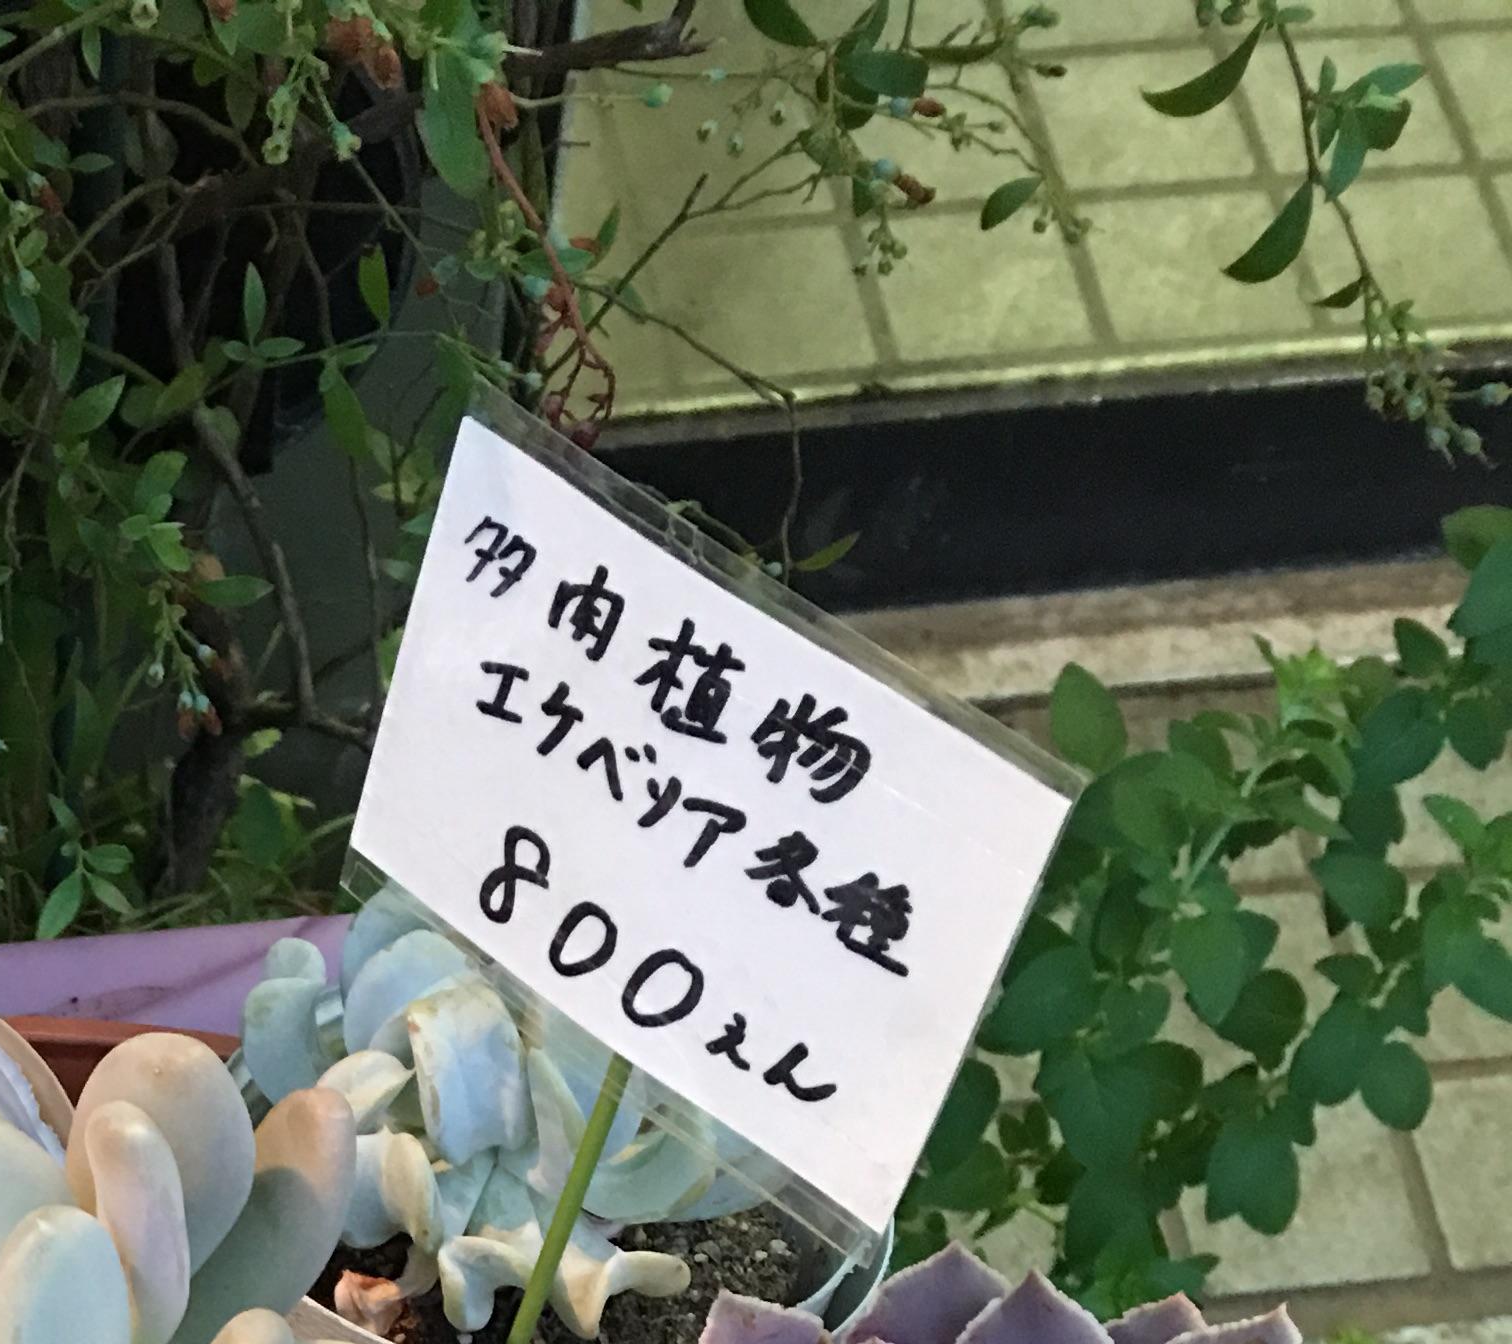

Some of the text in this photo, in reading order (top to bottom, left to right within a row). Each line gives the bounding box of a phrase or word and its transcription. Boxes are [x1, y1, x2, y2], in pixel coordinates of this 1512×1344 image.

[463, 515, 872, 804] 多肉植物
[479, 825, 839, 1103] 800えん
